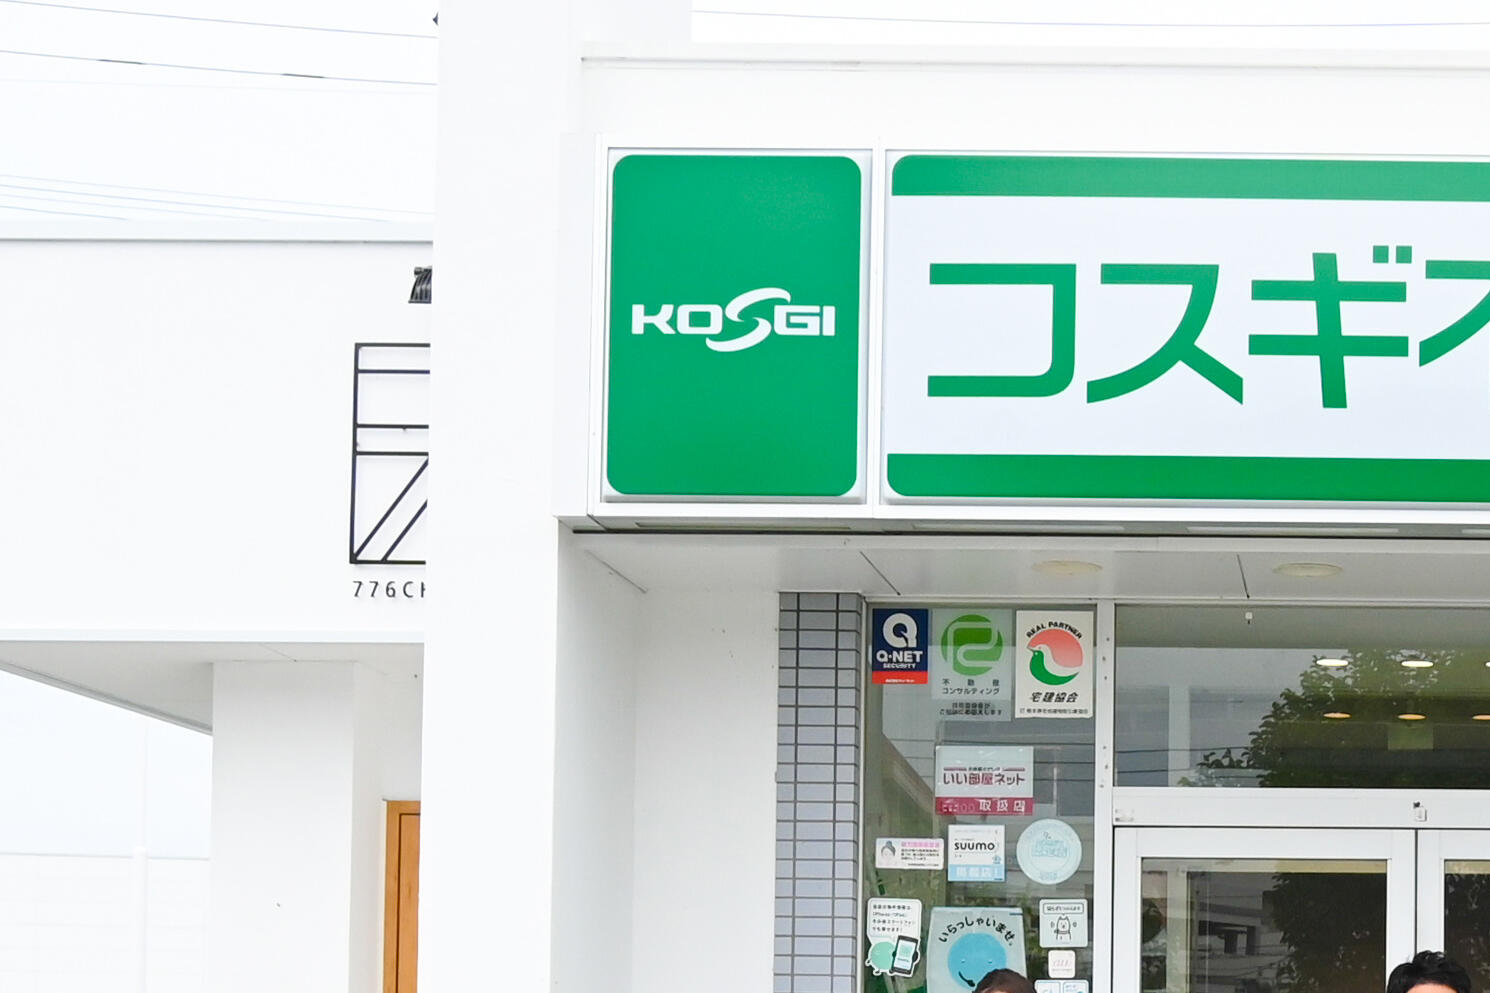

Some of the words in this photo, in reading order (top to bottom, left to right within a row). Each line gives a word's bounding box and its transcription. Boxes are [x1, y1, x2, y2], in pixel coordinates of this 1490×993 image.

[631, 287, 837, 353] KOSGI
[1026, 623, 1046, 638] REAL
[1048, 621, 1082, 639] PARTNER
[1031, 691, 1079, 703] 宅建協会
[942, 772, 1026, 786] いい部屋ネット
[954, 842, 996, 851] suumo
